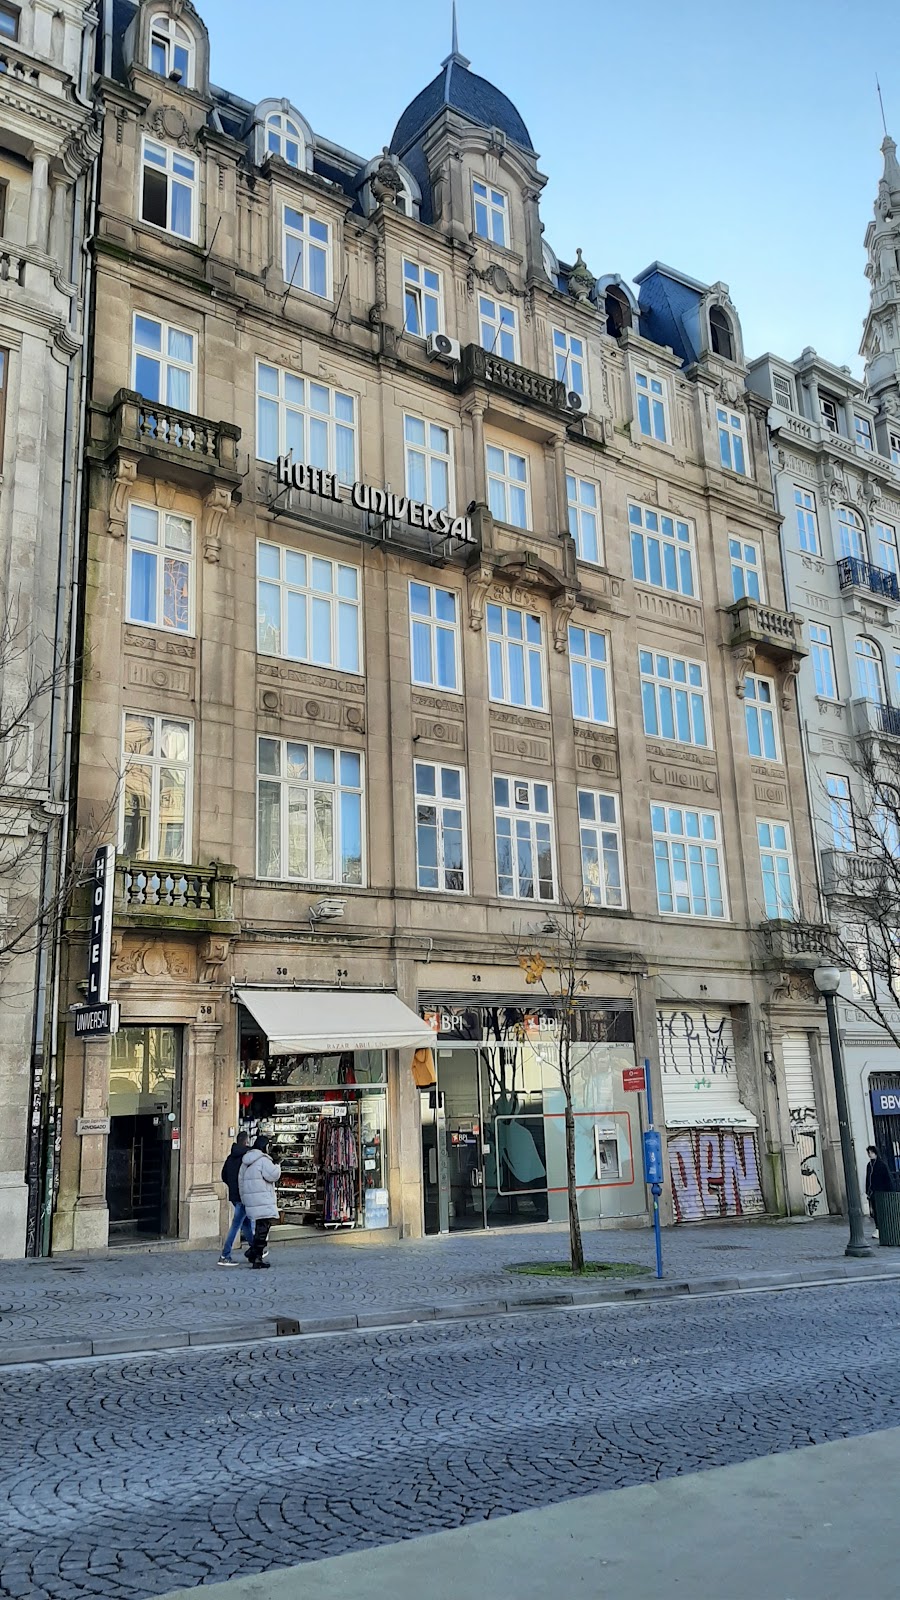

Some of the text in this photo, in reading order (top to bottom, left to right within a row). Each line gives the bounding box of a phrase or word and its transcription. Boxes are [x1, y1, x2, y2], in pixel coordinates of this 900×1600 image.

[277, 455, 477, 544] HOTEL UNIVERSAL
[90, 858, 105, 993] HOTEL
[337, 969, 348, 977] 34
[471, 974, 482, 982] 32
[200, 1005, 212, 1015] 38
[76, 1009, 108, 1031] UNIVERSAL
[442, 1015, 463, 1031] BPI
[539, 1017, 558, 1031] BPI
[880, 1095, 900, 1109] BBV
